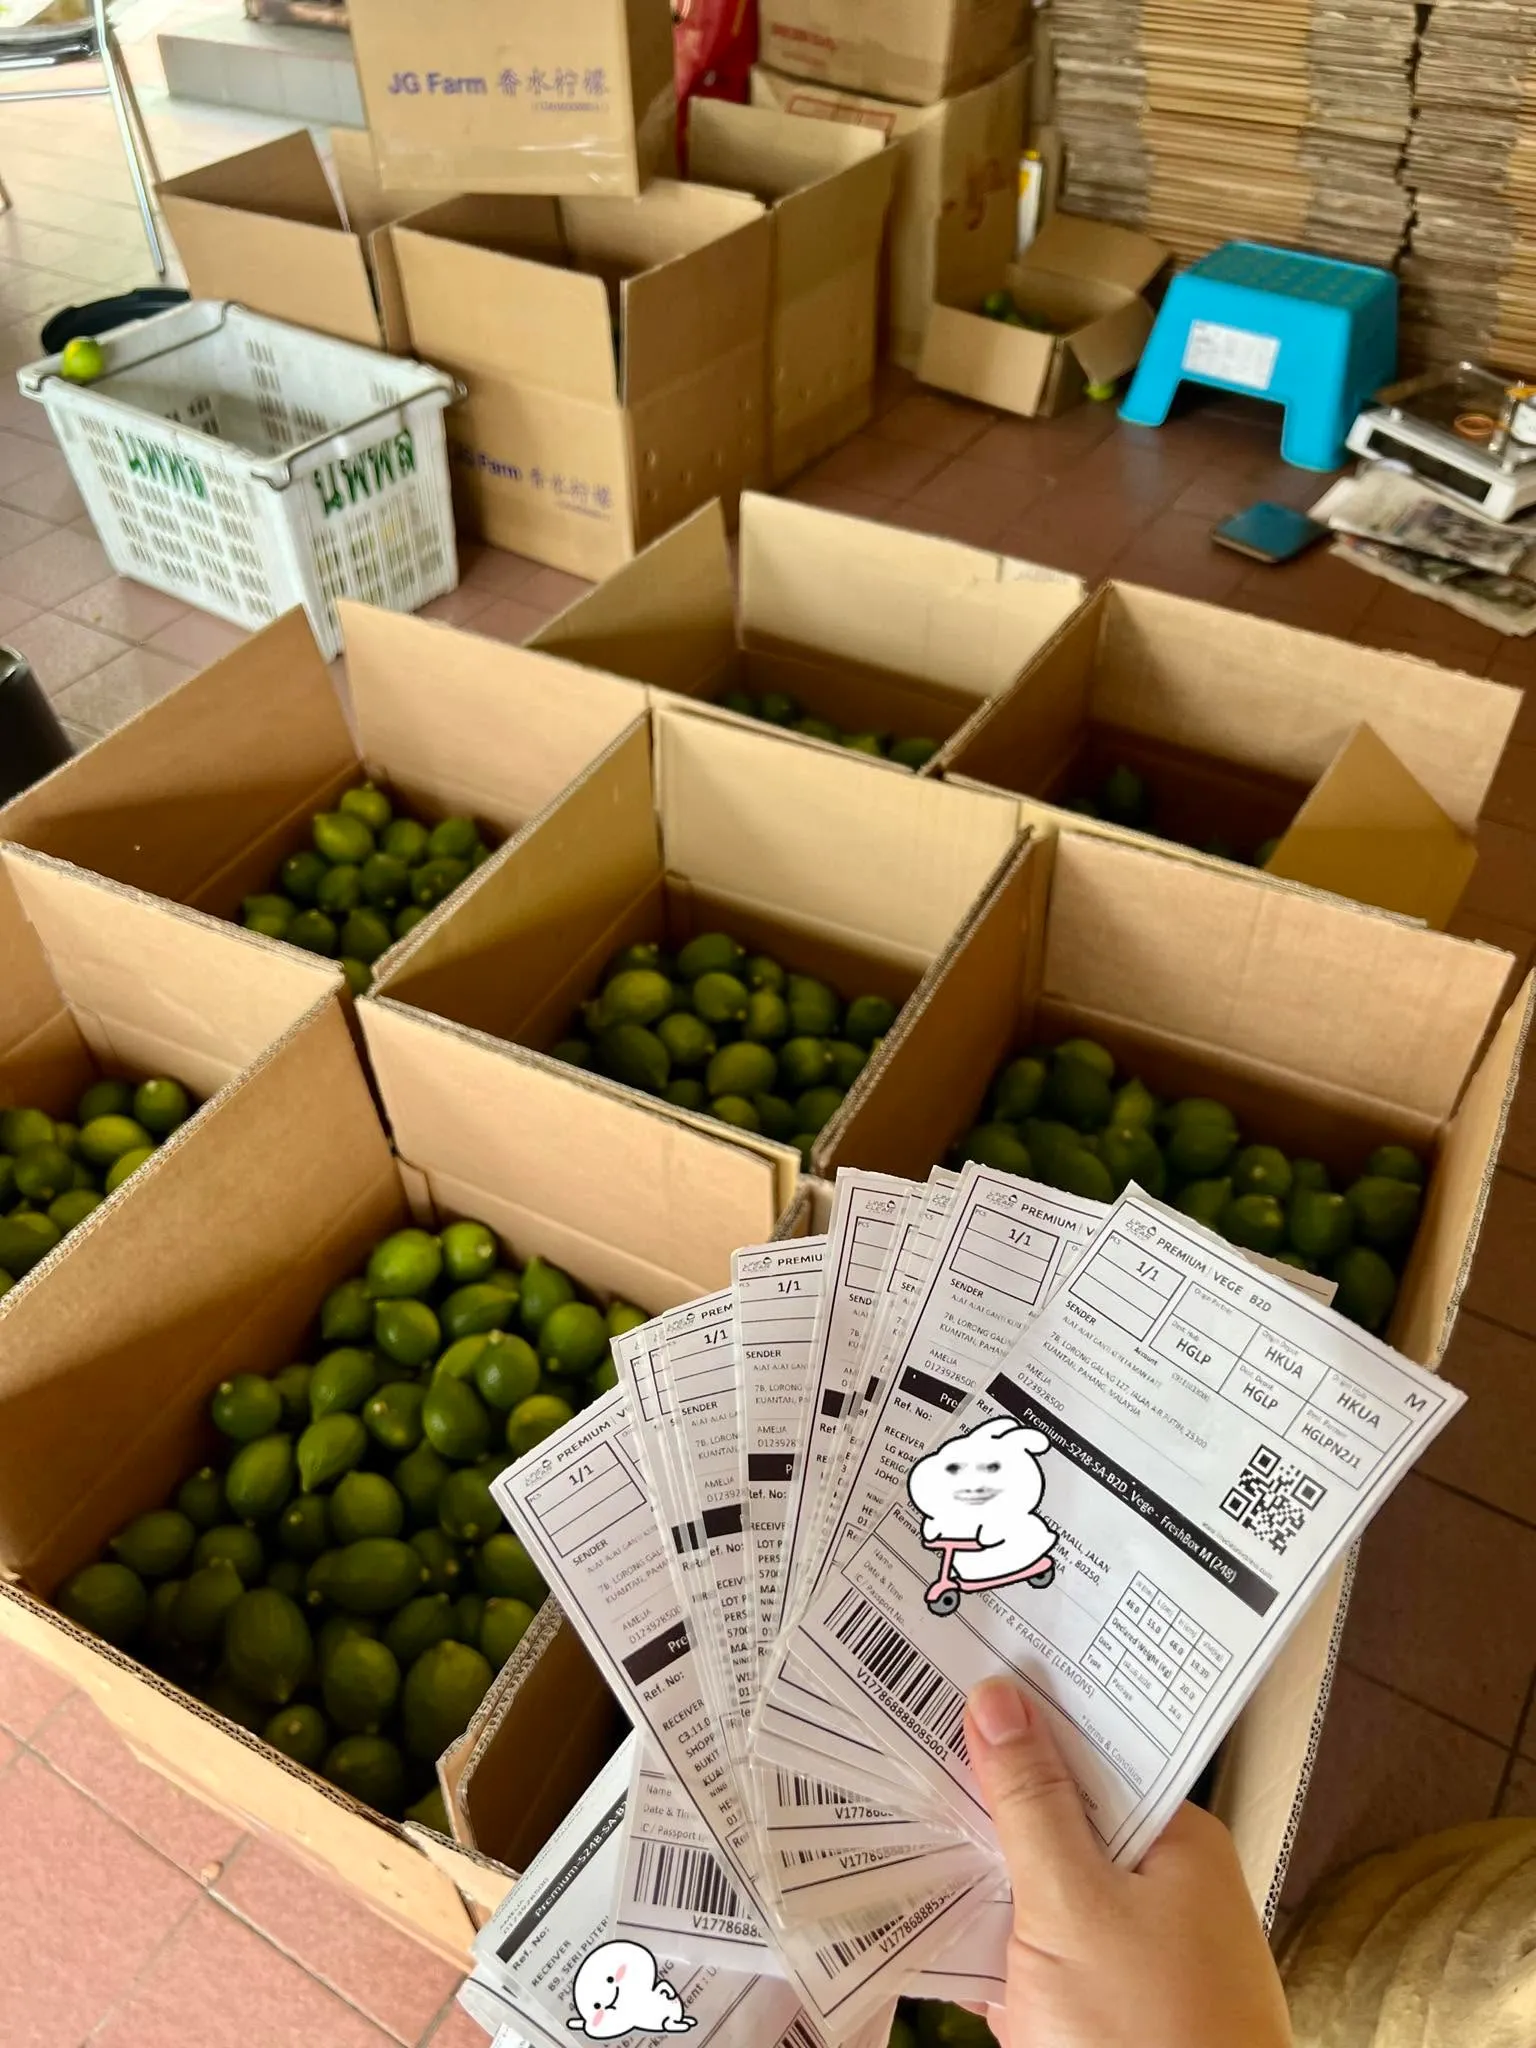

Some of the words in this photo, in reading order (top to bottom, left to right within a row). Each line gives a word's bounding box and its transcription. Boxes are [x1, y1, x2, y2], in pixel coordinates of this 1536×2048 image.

[388, 71, 420, 95] JG
[427, 72, 488, 95] Farm
[1021, 1203, 1077, 1231] PREMIUM
[1008, 1228, 1032, 1247] 1/1
[778, 1253, 823, 1266] PREMIU
[1135, 1261, 1160, 1282] 1/1
[1156, 1237, 1208, 1274] PREMIUM
[1213, 1271, 1244, 1296] VEGE
[1249, 1294, 1272, 1312] B2D
[777, 1280, 801, 1293] 1/1
[950, 1278, 984, 1299] SENDER
[849, 1293, 872, 1306] SEND
[701, 1303, 733, 1319] PREM
[1065, 1300, 1097, 1326] SENDER
[704, 1329, 728, 1345] 1/1
[957, 1318, 989, 1337] LORONG
[745, 1349, 782, 1358] SENDER
[1062, 1340, 1091, 1365] LORONG
[1133, 1346, 1158, 1367] Account
[1176, 1338, 1212, 1365] HGLP
[1264, 1346, 1305, 1380] HKUA
[1025, 1363, 1053, 1386] AMELIA
[769, 1383, 803, 1392] LORONG
[1017, 1372, 1065, 1412] 0123928500
[1242, 1382, 1279, 1410] HGLP
[681, 1401, 718, 1416] SENDER
[893, 1396, 912, 1412] Ref.
[914, 1406, 933, 1421] No:
[976, 1399, 994, 1417] Ref.
[1336, 1392, 1381, 1429] HKUA
[1403, 1392, 1428, 1413] M
[710, 1432, 738, 1444] LORON
[757, 1425, 787, 1434] AMELIA
[819, 1422, 837, 1436] Ref
[884, 1425, 925, 1450] RECEIVER
[556, 1420, 611, 1462] PREMIUM
[757, 1439, 797, 1447] 0123928
[885, 1443, 896, 1454] LG
[1301, 1422, 1363, 1469] HGLPN2J1
[568, 1464, 594, 1486] 1/1
[874, 1468, 900, 1485] JOHO
[769, 1489, 787, 1499] No:
[751, 1521, 786, 1532] RECEIVE
[893, 1508, 922, 1541] Remar
[573, 1538, 609, 1566] SENDER
[725, 1543, 744, 1553] No:
[757, 1539, 774, 1549] LOT
[1160, 1515, 1200, 1553] FreshBox
[1198, 1546, 1212, 1563] M
[1209, 1556, 1238, 1584] (248)
[612, 1560, 645, 1584] LORONG
[863, 1561, 881, 1579] Date
[1084, 1550, 1111, 1574] JALAN
[866, 1585, 896, 1617] Passport
[1006, 1615, 1016, 1627] &
[1015, 1623, 1054, 1658] FRAGILE
[1098, 1635, 1113, 1651] Date
[1111, 1617, 1138, 1645] Declared
[1136, 1639, 1160, 1667] Weight
[643, 1683, 665, 1702] Ref.
[665, 1671, 684, 1687] No:
[662, 1698, 705, 1732] RECEIVER
[856, 1667, 949, 1762] V177868888085001
[694, 1750, 720, 1773] BUKIT
[646, 1783, 672, 1797] Name
[666, 1807, 673, 1817] &
[657, 1825, 696, 1842] Passport
[692, 1914, 763, 1938] V1778688
[512, 1949, 533, 1971] Ref.
[531, 1926, 550, 1946] No:
[562, 1951, 583, 1974] SERI
[581, 1915, 609, 1952] PUTER
[531, 1940, 572, 1987] RECEIVER
